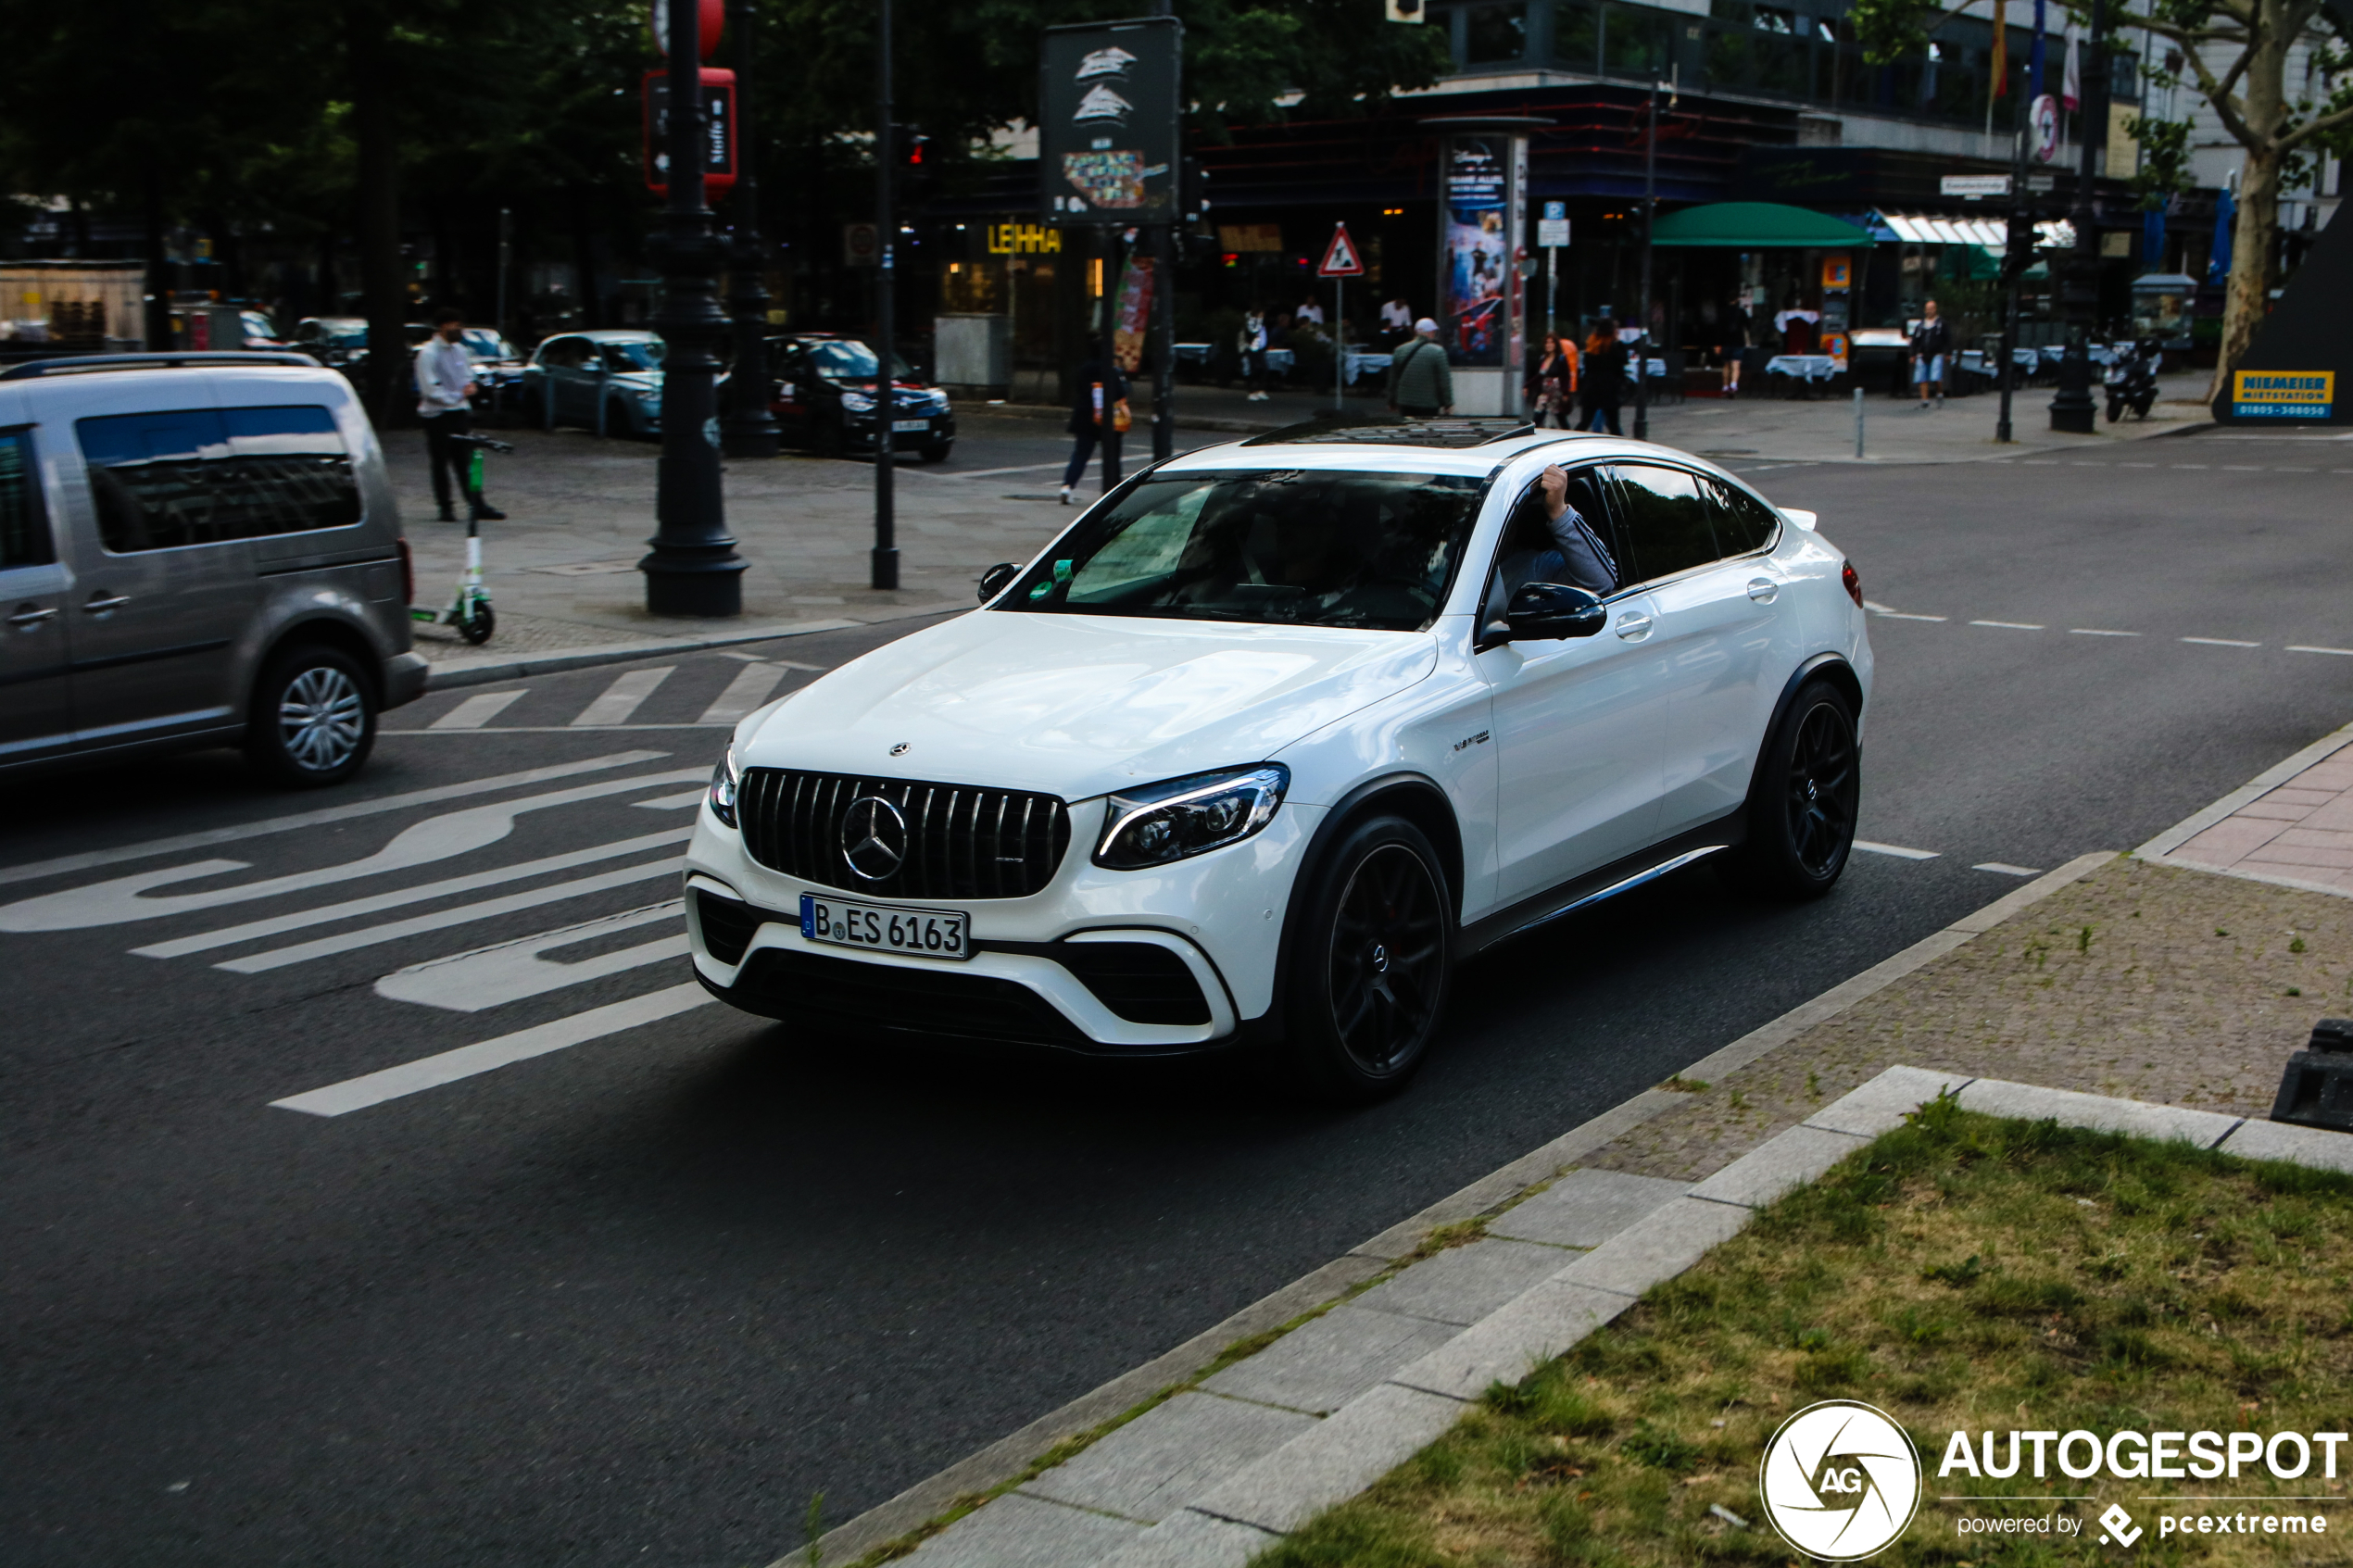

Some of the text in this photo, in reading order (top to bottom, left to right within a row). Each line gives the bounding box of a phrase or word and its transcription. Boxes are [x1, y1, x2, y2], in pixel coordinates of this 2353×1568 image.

[2244, 376, 2326, 390] NIEMEIER
[2243, 392, 2324, 400] MIETSTATION
[815, 903, 831, 935] B
[888, 914, 962, 952] 6163
